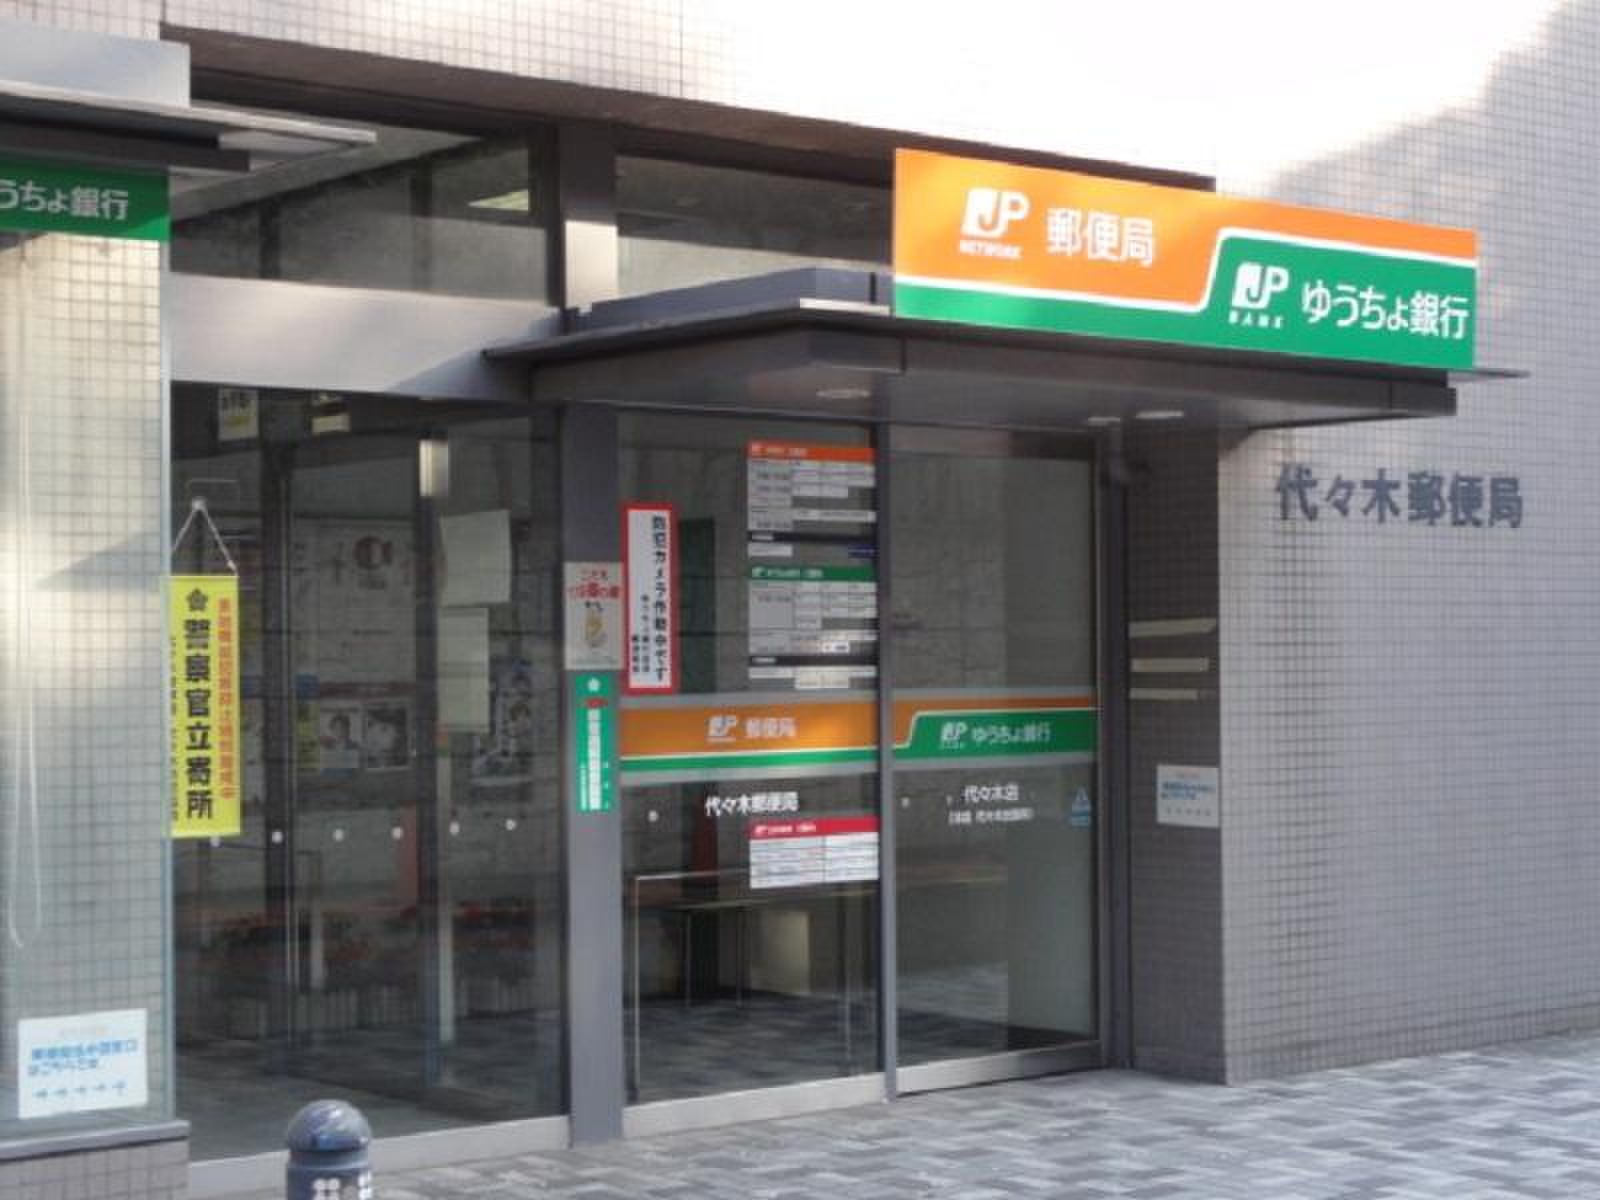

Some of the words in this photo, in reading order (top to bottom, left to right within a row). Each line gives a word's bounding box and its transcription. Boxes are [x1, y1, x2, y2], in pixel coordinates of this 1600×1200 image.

[1046, 207, 1158, 268] 郵便局
[1301, 279, 1470, 340] ゆうちょ銀行
[1276, 462, 1524, 529] 代々木郵便局
